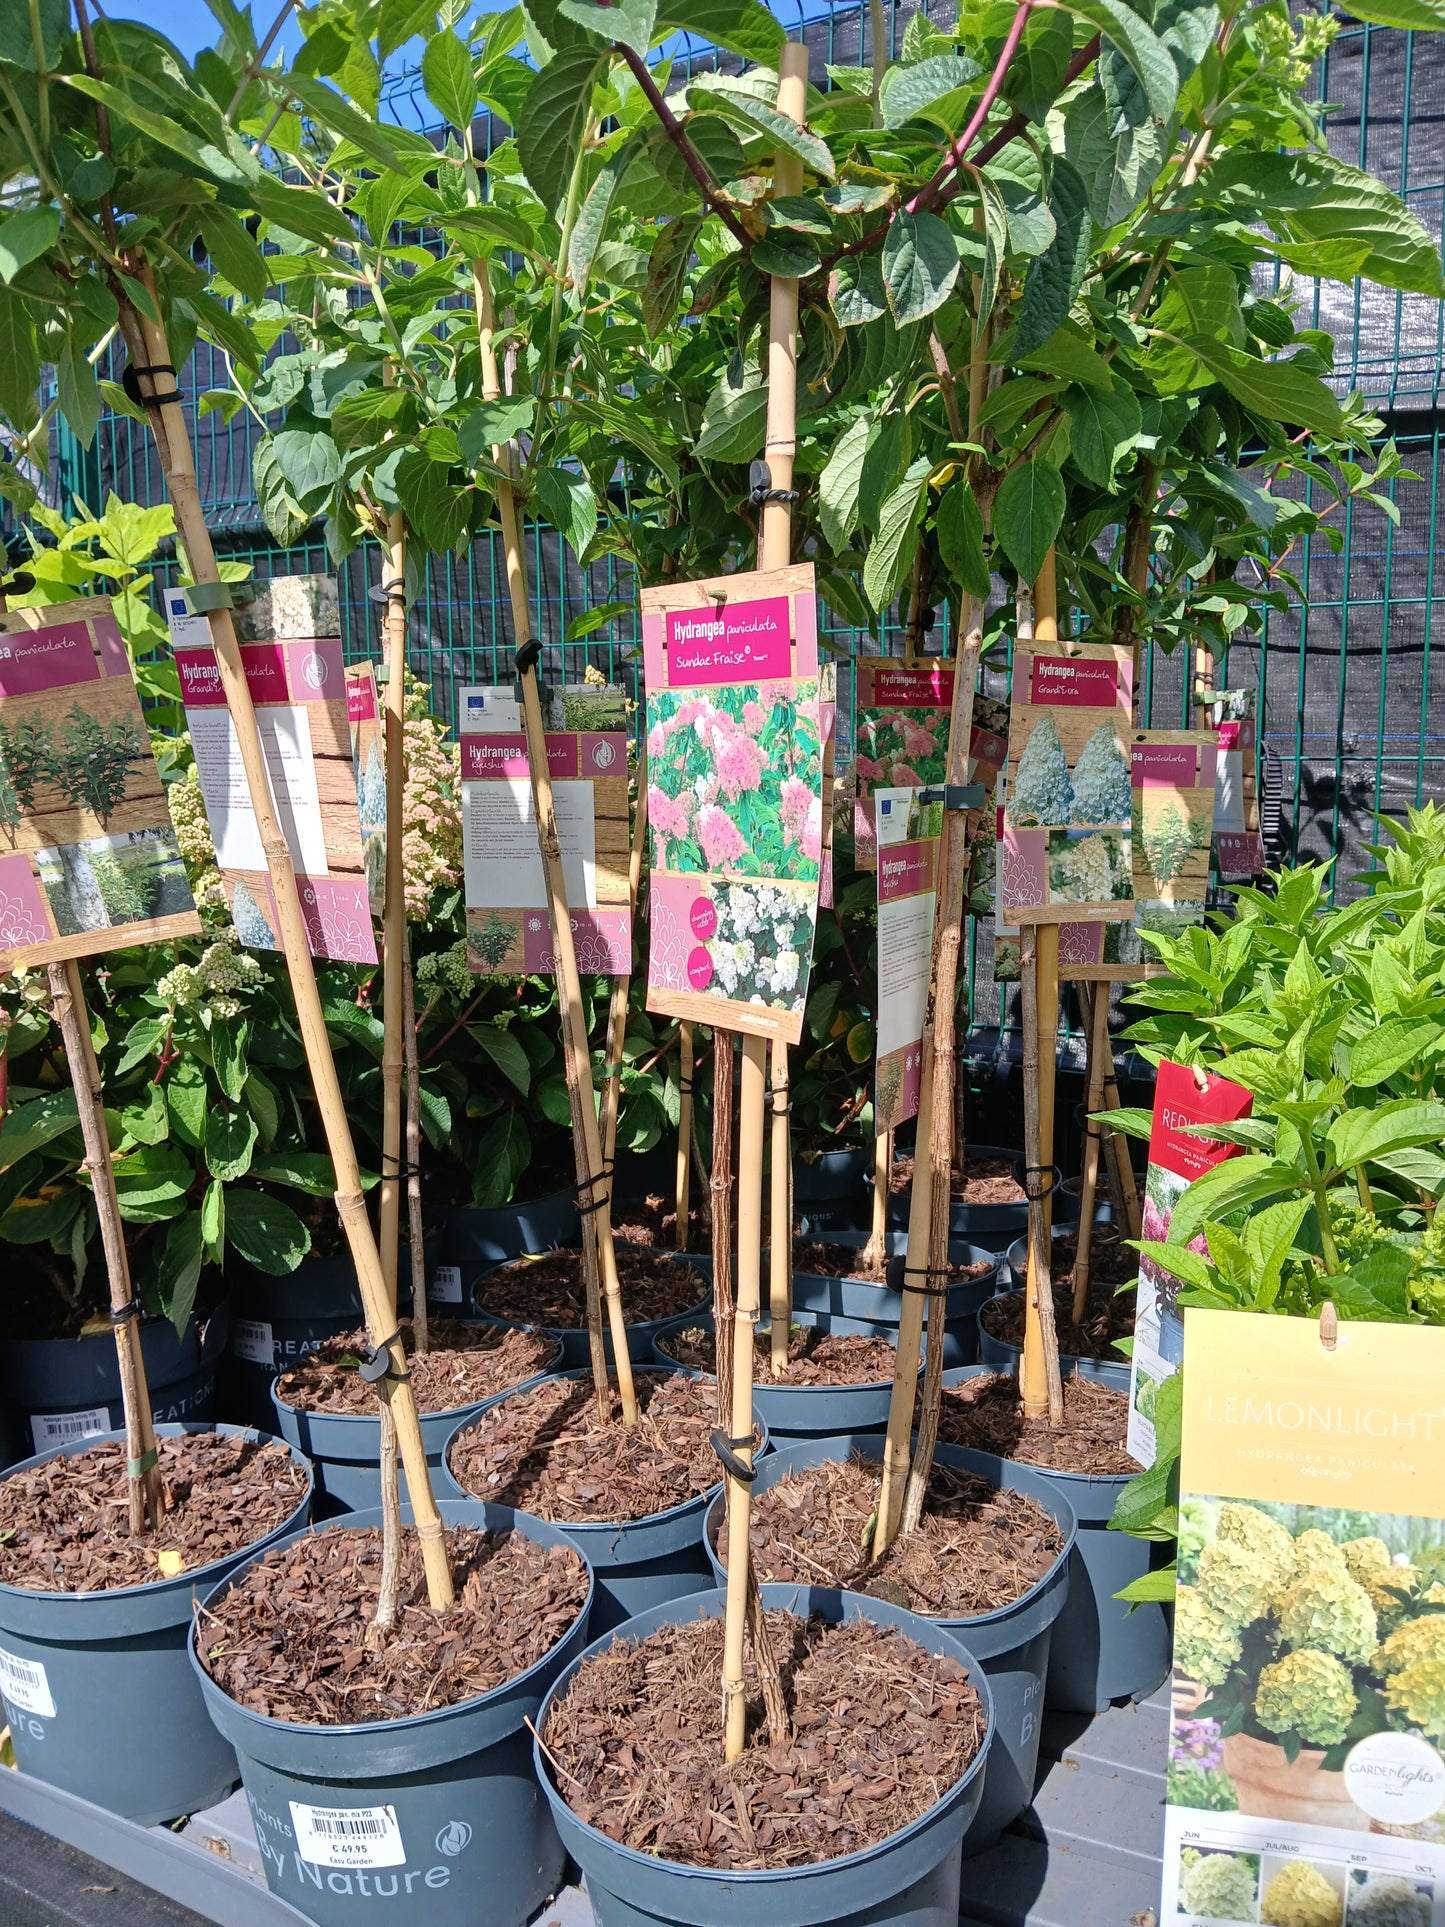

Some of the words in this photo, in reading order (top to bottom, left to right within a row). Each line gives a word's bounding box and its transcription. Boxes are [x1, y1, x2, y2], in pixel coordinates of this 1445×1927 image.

[674, 619, 725, 645] Hydrangea
[726, 615, 778, 643] paniculata
[14, 636, 77, 664] paniculata
[676, 651, 712, 668] Sundae
[182, 663, 220, 683] Hydrang
[880, 674, 917, 686] Hydrangea
[1039, 662, 1075, 679] Hydrangea
[1075, 669, 1110, 682] paniculata
[881, 690, 908, 698] Sundae
[469, 745, 521, 761] Hydrangea
[1144, 754, 1188, 766] paniculata
[471, 760, 504, 775] Kyushu
[882, 859, 907, 878] Hydrangea
[1207, 1395, 1441, 1440] LEMONLIGHT
[1237, 1448, 1322, 1465] HYDRANGEA
[1328, 1456, 1417, 1472] PANICULATA
[247, 1790, 292, 1838] Plants
[361, 1810, 373, 1818] P23
[1183, 1831, 1200, 1839] JUN
[255, 1821, 285, 1878] By
[332, 1844, 339, 1853] €
[341, 1844, 368, 1854] 49.95
[1265, 1841, 1300, 1853] JUL/AUG
[329, 1856, 345, 1865] Easy
[346, 1856, 374, 1865] Garden
[1350, 1854, 1367, 1863] SEP
[294, 1850, 450, 1897] Nature
[1415, 1864, 1433, 1874] OCT
